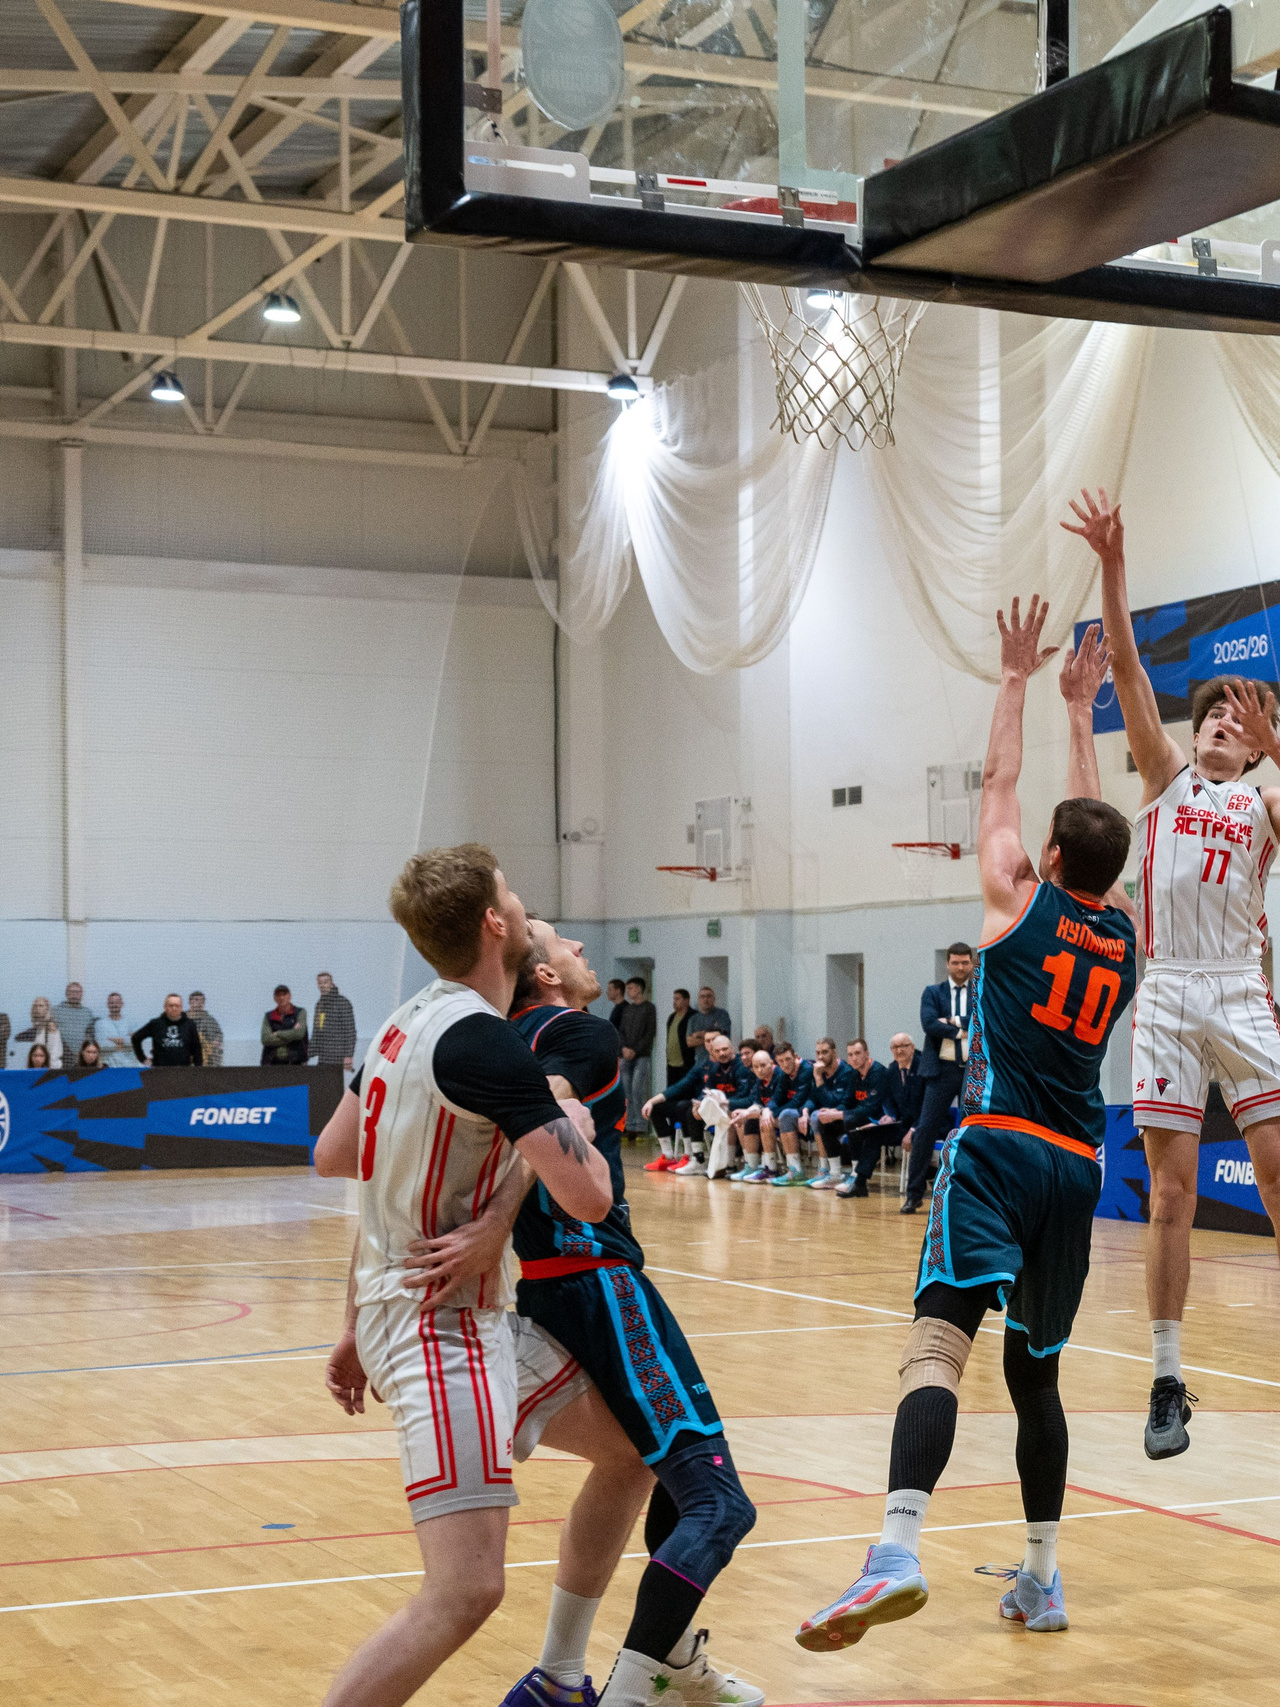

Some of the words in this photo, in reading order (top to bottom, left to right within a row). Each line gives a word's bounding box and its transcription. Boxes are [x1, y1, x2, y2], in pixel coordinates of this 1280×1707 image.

[1213, 633, 1269, 665] 2025/26
[1226, 802, 1251, 811] BET
[1229, 794, 1254, 804] FON
[1200, 847, 1232, 886] 77
[1030, 949, 1122, 1046] 10
[189, 1106, 277, 1126] FONBET
[1214, 1158, 1258, 1187] FONB
[886, 1506, 918, 1518] adidas
